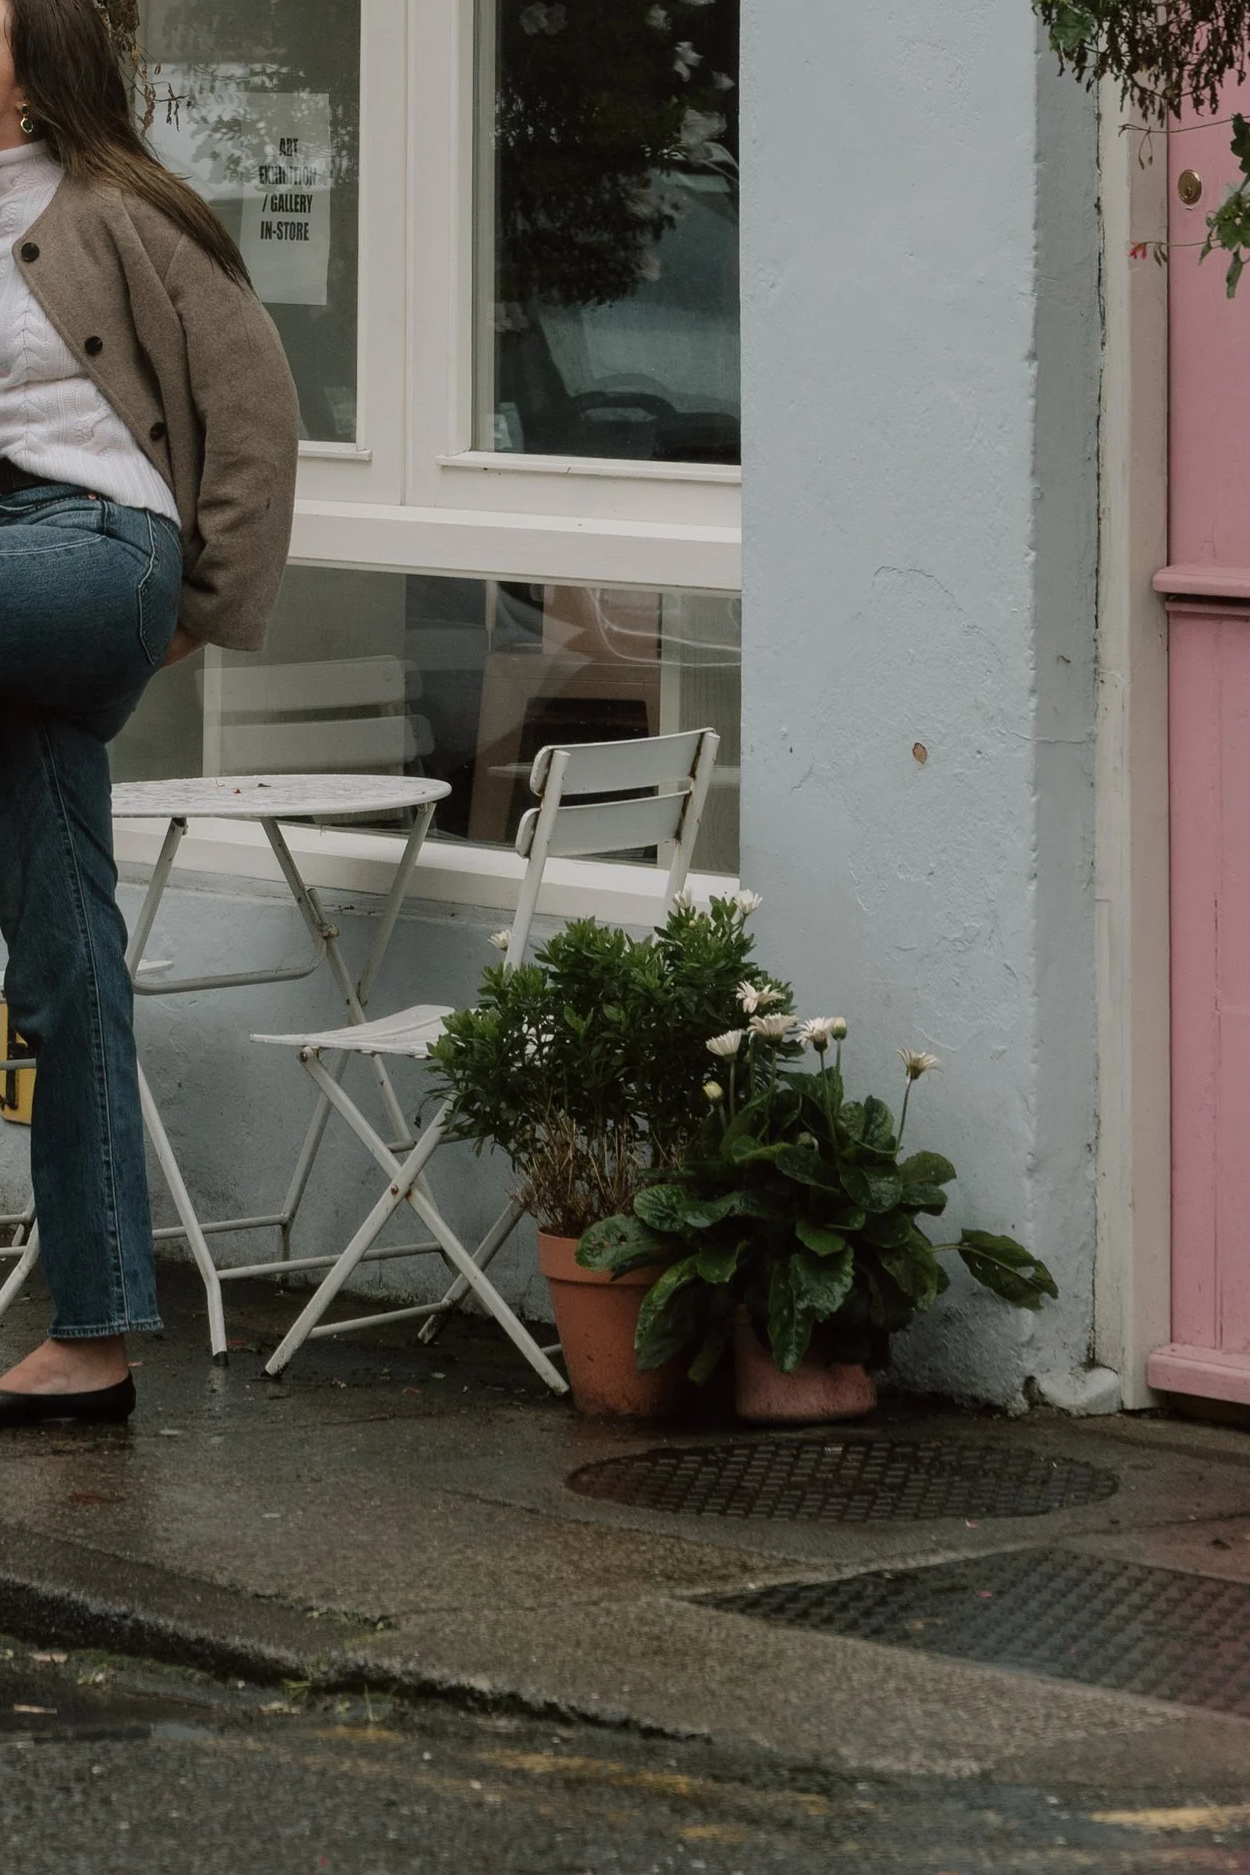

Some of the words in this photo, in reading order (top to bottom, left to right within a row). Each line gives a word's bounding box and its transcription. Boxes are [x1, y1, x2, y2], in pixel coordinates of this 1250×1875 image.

[278, 138, 299, 157] ART
[270, 194, 313, 214] GALLERY
[260, 221, 309, 241] IN-STORE
